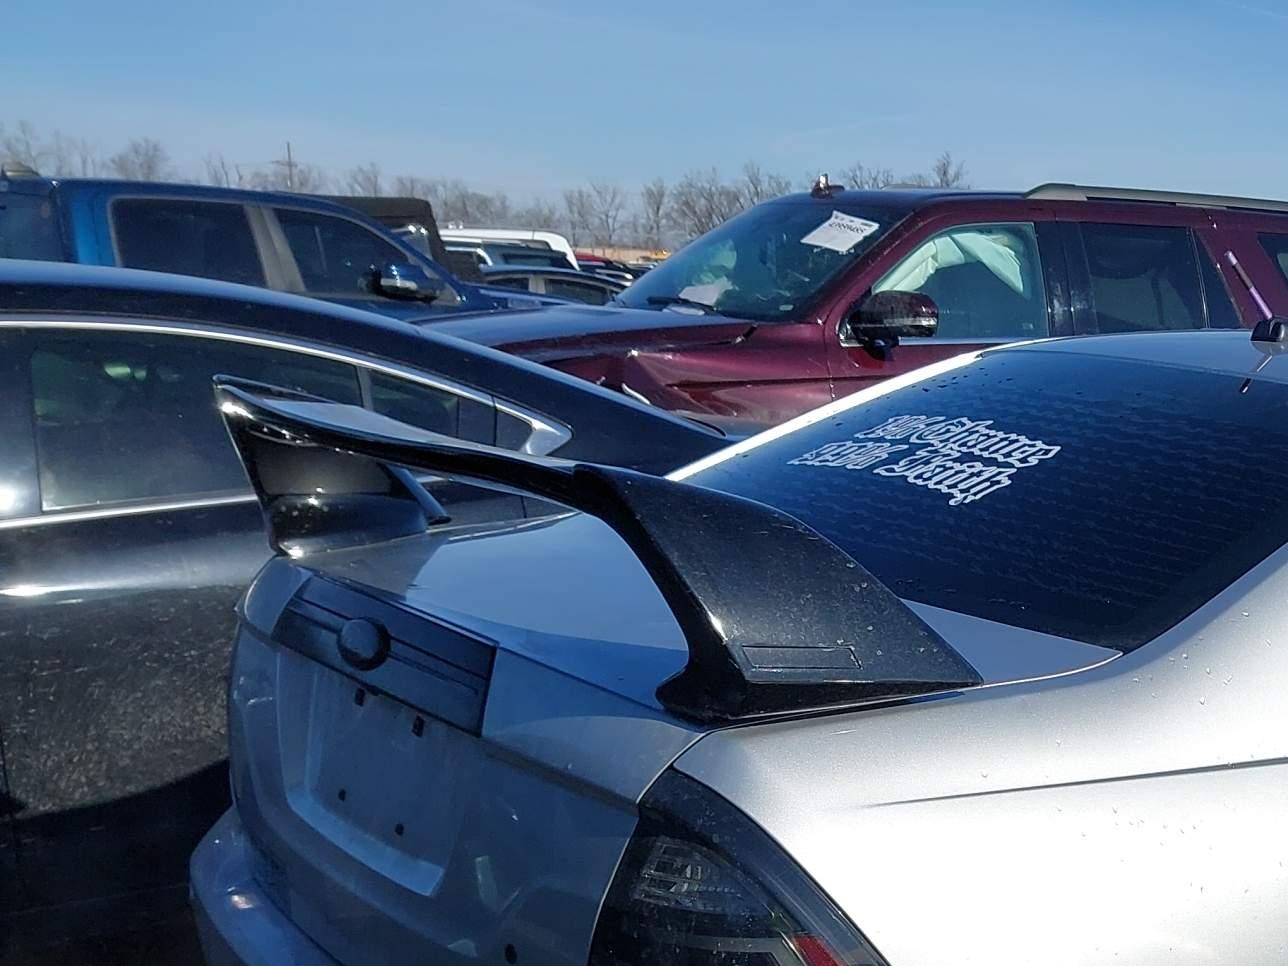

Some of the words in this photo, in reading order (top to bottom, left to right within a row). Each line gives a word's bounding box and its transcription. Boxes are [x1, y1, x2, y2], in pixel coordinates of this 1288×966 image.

[909, 416, 1062, 468] Chance
[786, 441, 910, 470] 99%
[872, 442, 1018, 506] Faith
